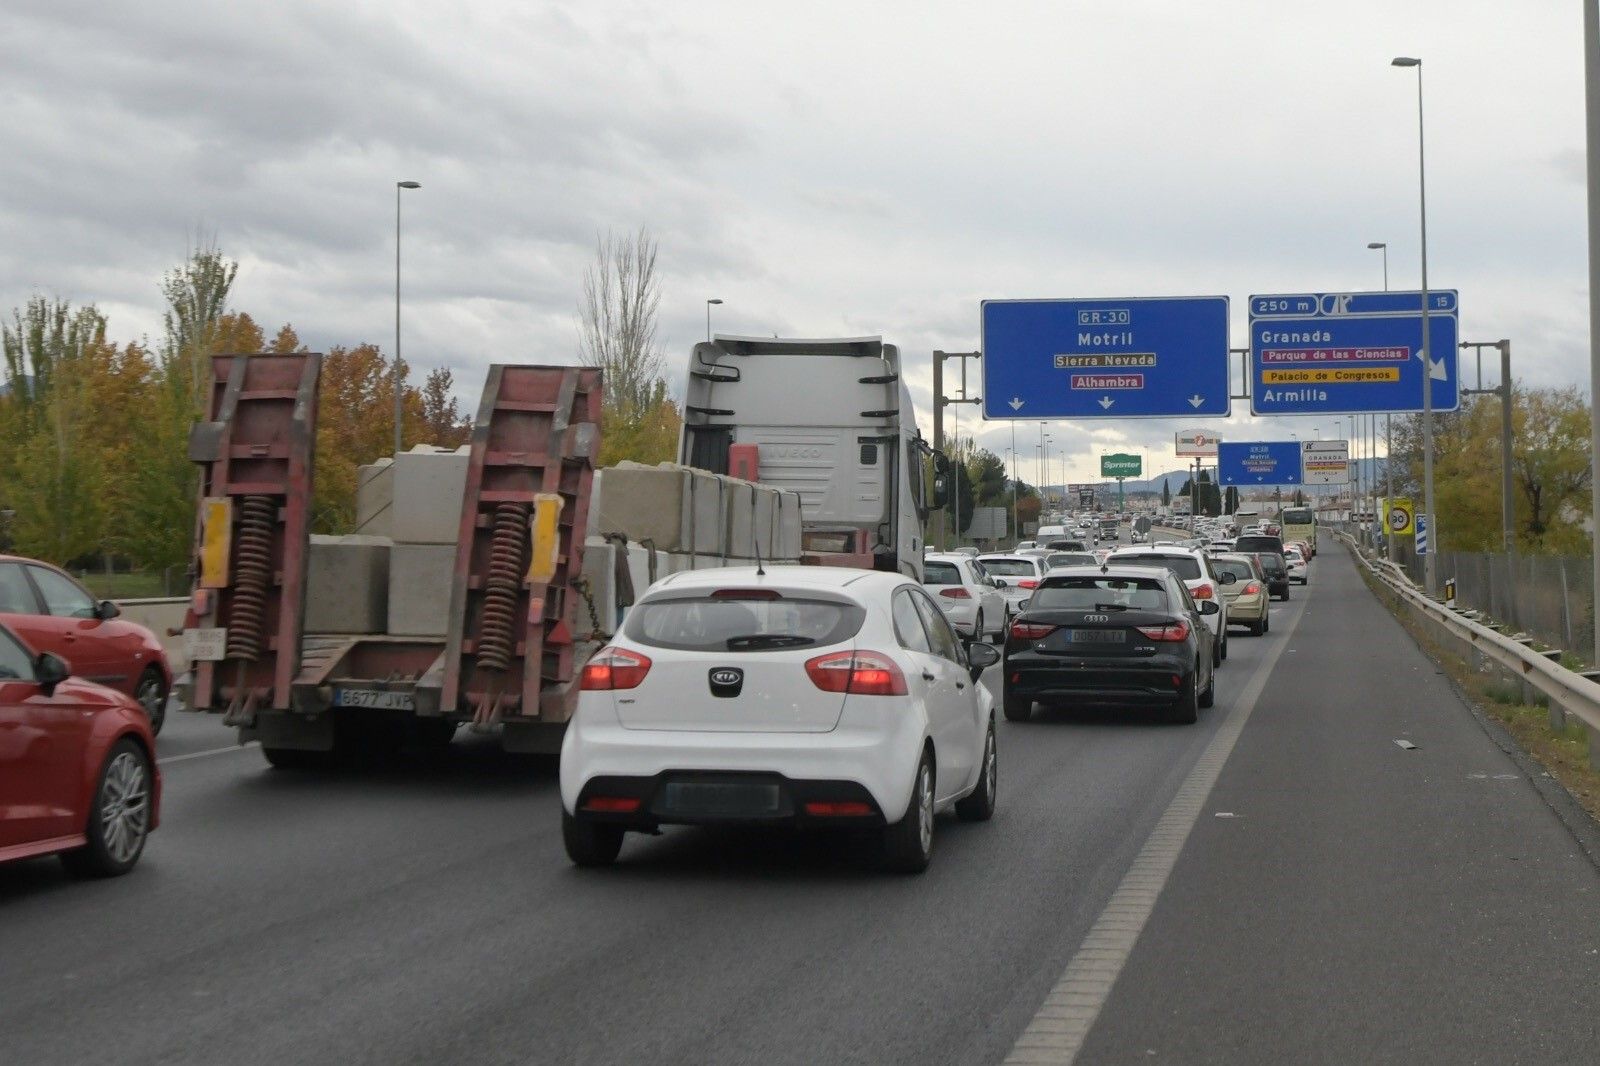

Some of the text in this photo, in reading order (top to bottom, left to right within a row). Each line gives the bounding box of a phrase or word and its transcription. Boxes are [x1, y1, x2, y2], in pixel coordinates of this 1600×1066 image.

[1259, 300, 1309, 312] 250 m
[1436, 296, 1448, 308] 15
[1080, 312, 1128, 323] GR-30
[1078, 332, 1133, 346] Motril
[1261, 330, 1332, 344] Granada
[1056, 354, 1155, 367] Sierra Nevada
[1269, 348, 1402, 361] Parque de las Ciencias
[1271, 370, 1390, 381] Palacio de Congresos
[1076, 376, 1138, 388] Alhambra
[1263, 389, 1328, 402] Armilla
[1103, 461, 1140, 469] Sprinter
[716, 673, 736, 681] KIA
